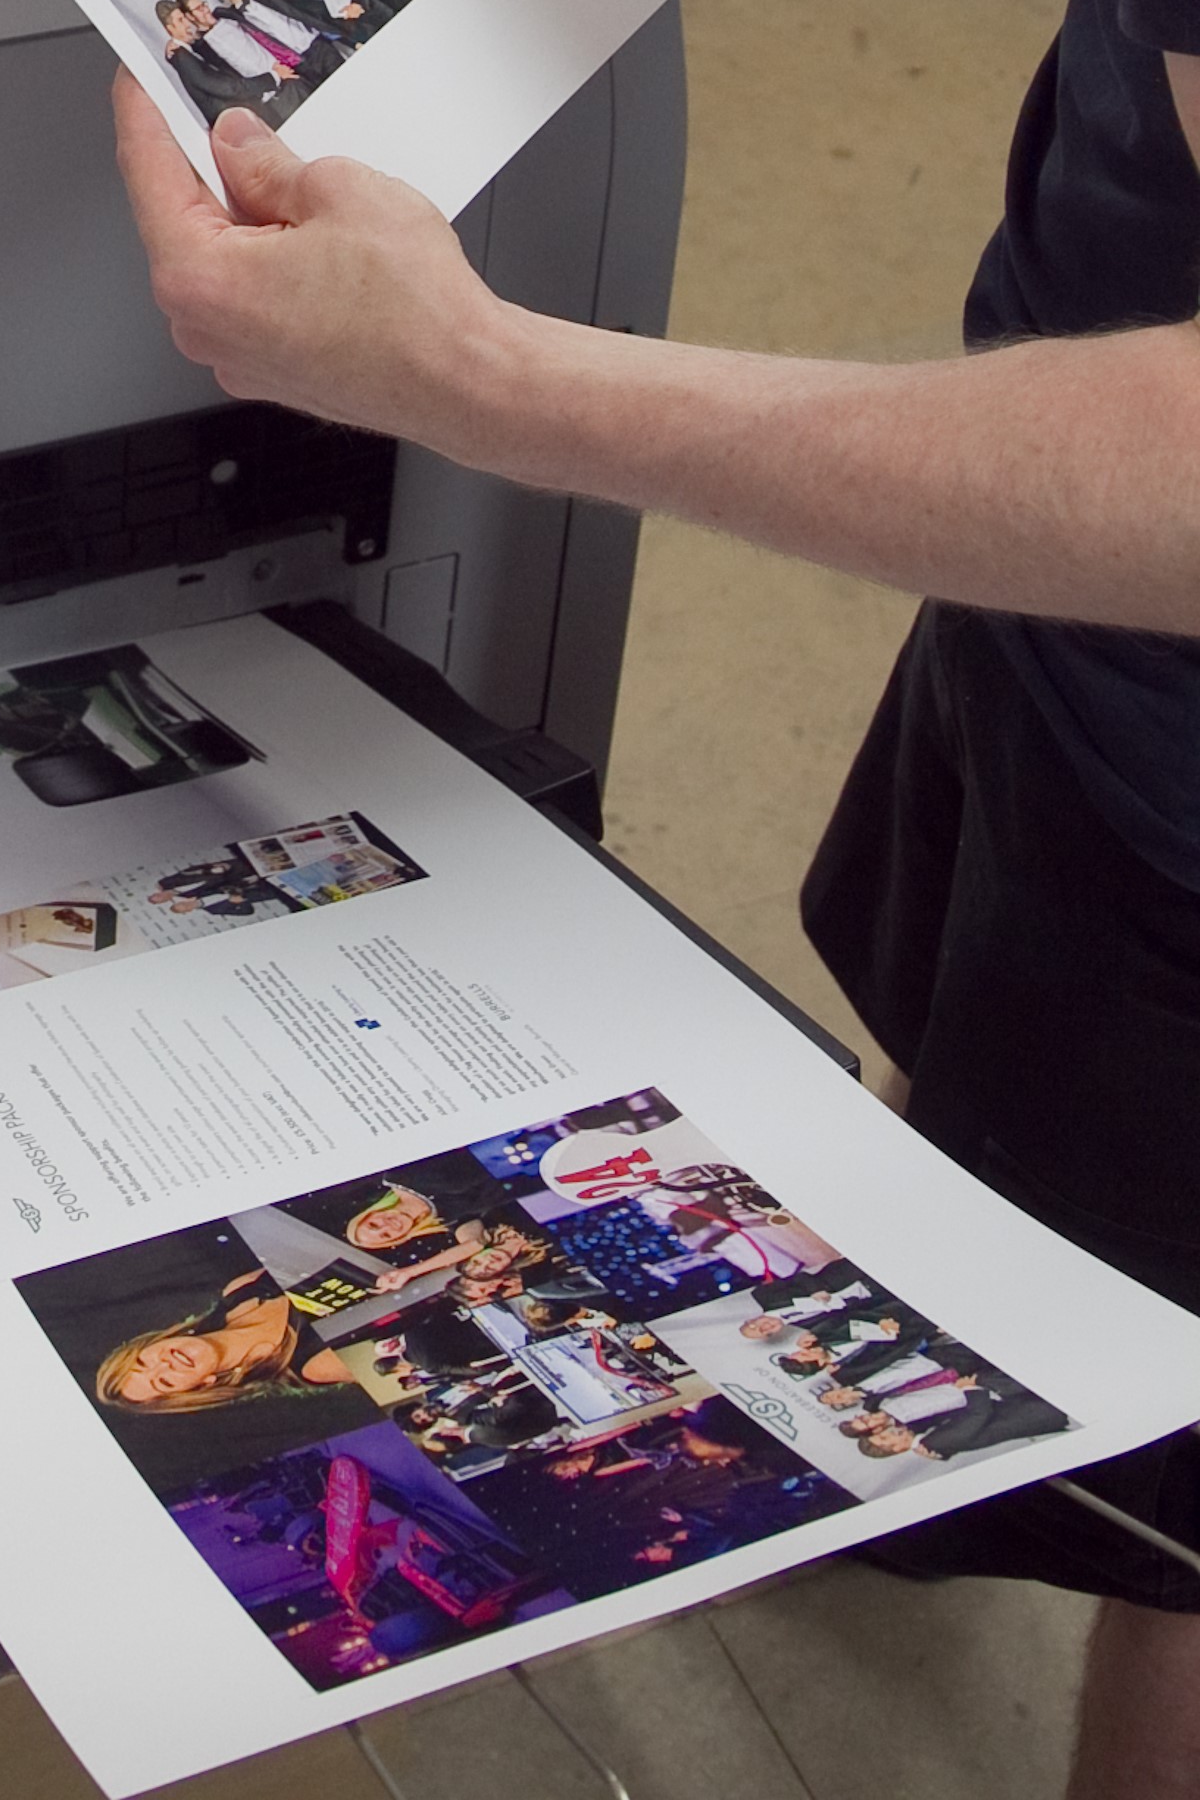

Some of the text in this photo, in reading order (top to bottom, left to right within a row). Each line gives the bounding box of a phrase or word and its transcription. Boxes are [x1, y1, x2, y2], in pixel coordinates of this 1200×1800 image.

[466, 983, 511, 1020] BURRELLS
[37, 1077, 50, 1088] that
[45, 1088, 72, 1114] packages
[81, 1137, 105, 1160] support
[10, 1128, 90, 1222] SPONSORSHIP
[98, 1160, 122, 1183] offering
[117, 1163, 145, 1190] following
[555, 1147, 662, 1199] 24
[117, 1185, 128, 1194] are
[123, 1195, 136, 1206] We
[137, 1191, 151, 1202] the
